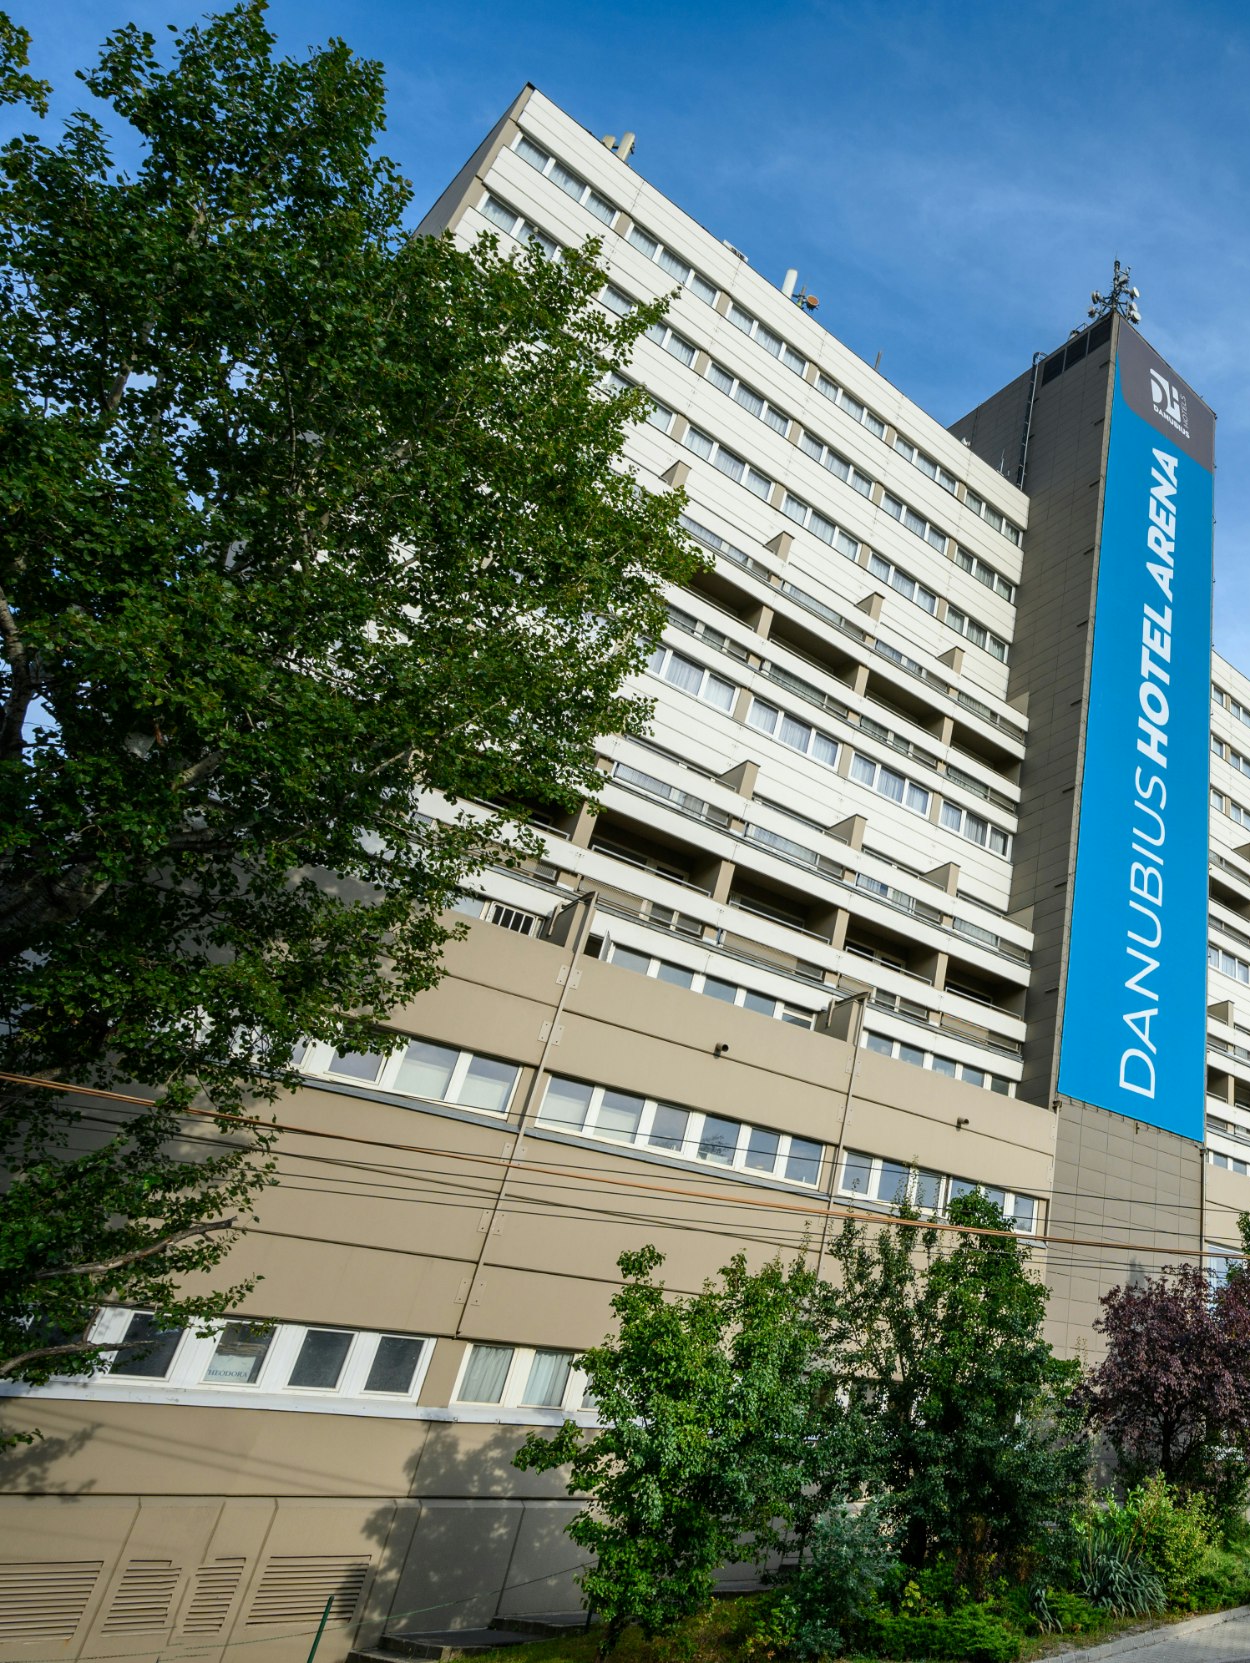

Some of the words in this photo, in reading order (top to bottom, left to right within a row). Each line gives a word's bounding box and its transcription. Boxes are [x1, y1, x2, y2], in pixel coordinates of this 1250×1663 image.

[1153, 403, 1190, 439] DANUBIUS
[1180, 394, 1190, 429] HOTELS
[1146, 447, 1178, 603] ARENA
[1136, 604, 1172, 769] HOTEL
[1119, 767, 1167, 1099] DANUBIUS
[207, 1369, 248, 1378] HEODORA
